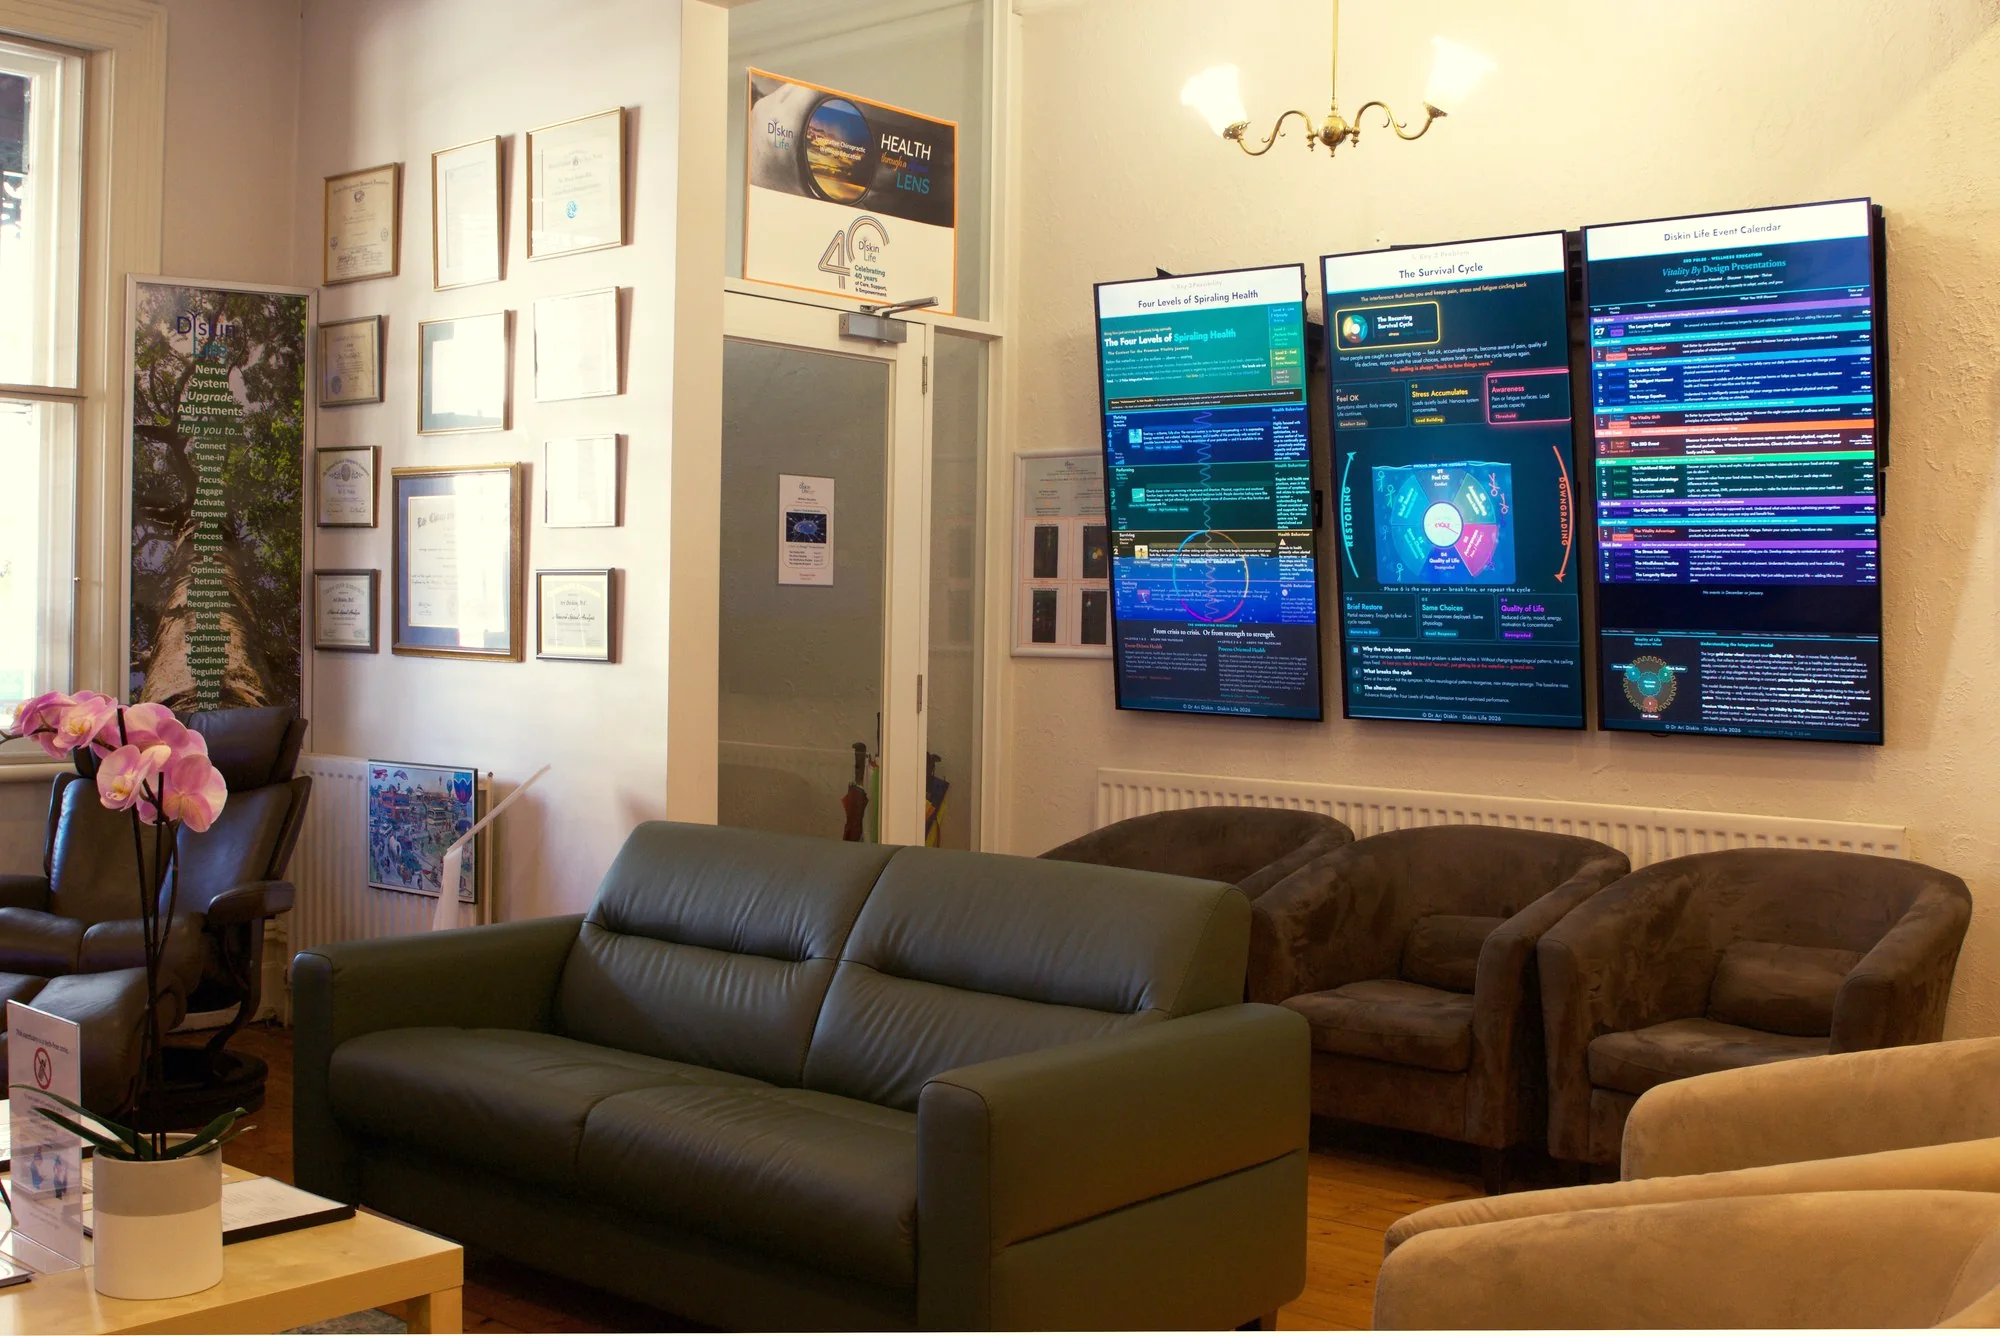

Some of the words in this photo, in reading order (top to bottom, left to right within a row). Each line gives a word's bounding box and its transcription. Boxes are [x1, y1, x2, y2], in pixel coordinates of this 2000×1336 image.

[768, 121, 793, 139] Diskin
[774, 138, 789, 150] Life
[840, 141, 866, 153] Chiropractic
[881, 133, 931, 161] HEALTH
[896, 173, 930, 194] LENS
[1664, 233, 1691, 241] Diskin
[1694, 230, 1710, 239] Life
[1713, 228, 1737, 236] Event
[1740, 224, 1781, 234] Calendar
[859, 238, 879, 253] Diskin
[864, 252, 876, 263] Life
[855, 265, 885, 277] Celebrating
[1399, 270, 1415, 279] The
[1418, 266, 1455, 276] Survival
[1458, 263, 1483, 274] Cycle
[1663, 268, 1689, 277] Vitality
[1691, 266, 1701, 276] By
[1703, 264, 1730, 274] Design
[1731, 260, 1786, 271] Presentations
[1138, 300, 1155, 308] Four
[1158, 296, 1181, 307] Levels
[1184, 295, 1191, 304] of
[1194, 292, 1230, 304] Spiraling
[1232, 290, 1258, 300] Health
[1399, 321, 1413, 329] Cycle
[1104, 338, 1119, 347] The
[1120, 337, 1137, 346] Four
[1138, 334, 1162, 345] Levels
[1164, 332, 1173, 343] of
[1174, 332, 1209, 344] Spiraling
[1210, 328, 1236, 339] Health
[195, 365, 227, 376] Nerve
[191, 378, 229, 390] System
[1431, 388, 1468, 397] Accumulates
[1492, 386, 1524, 394] Awareness
[188, 390, 233, 404] Upgrade
[177, 404, 243, 417] Adjustments
[177, 424, 201, 436] Help
[203, 426, 222, 438] you
[194, 441, 226, 451] Connect
[196, 453, 225, 462] Tune-in
[199, 465, 221, 473] Sense
[199, 476, 221, 484] Focus
[196, 487, 223, 497] Engage
[194, 499, 225, 507] Activate
[190, 510, 228, 520] Empower
[1559, 476, 1568, 546] DOWNGRADING
[1344, 486, 1353, 547] RESTORING
[200, 521, 219, 529] Flow
[194, 533, 223, 541] Process
[194, 544, 223, 553] Express
[203, 555, 213, 563] Be
[191, 566, 225, 576] Optimize
[194, 578, 222, 586] Retrain
[187, 589, 229, 599] Reprogram
[187, 600, 230, 610] Reorganize
[1440, 604, 1463, 612] Choices
[1501, 605, 1523, 613] Quality
[195, 612, 221, 620] Evolve
[196, 623, 220, 631] Relate
[1168, 628, 1180, 636] crisis
[1187, 628, 1201, 636] crisis.
[1224, 630, 1246, 639] strength
[1253, 631, 1276, 639] strength.
[185, 634, 231, 644] Synchronize
[191, 645, 225, 653] Calibrate
[187, 656, 229, 665] Coordinate
[191, 668, 225, 677] Regulate
[196, 679, 220, 688] Adjust
[197, 690, 219, 700] Adapt
[198, 701, 218, 711] Align
